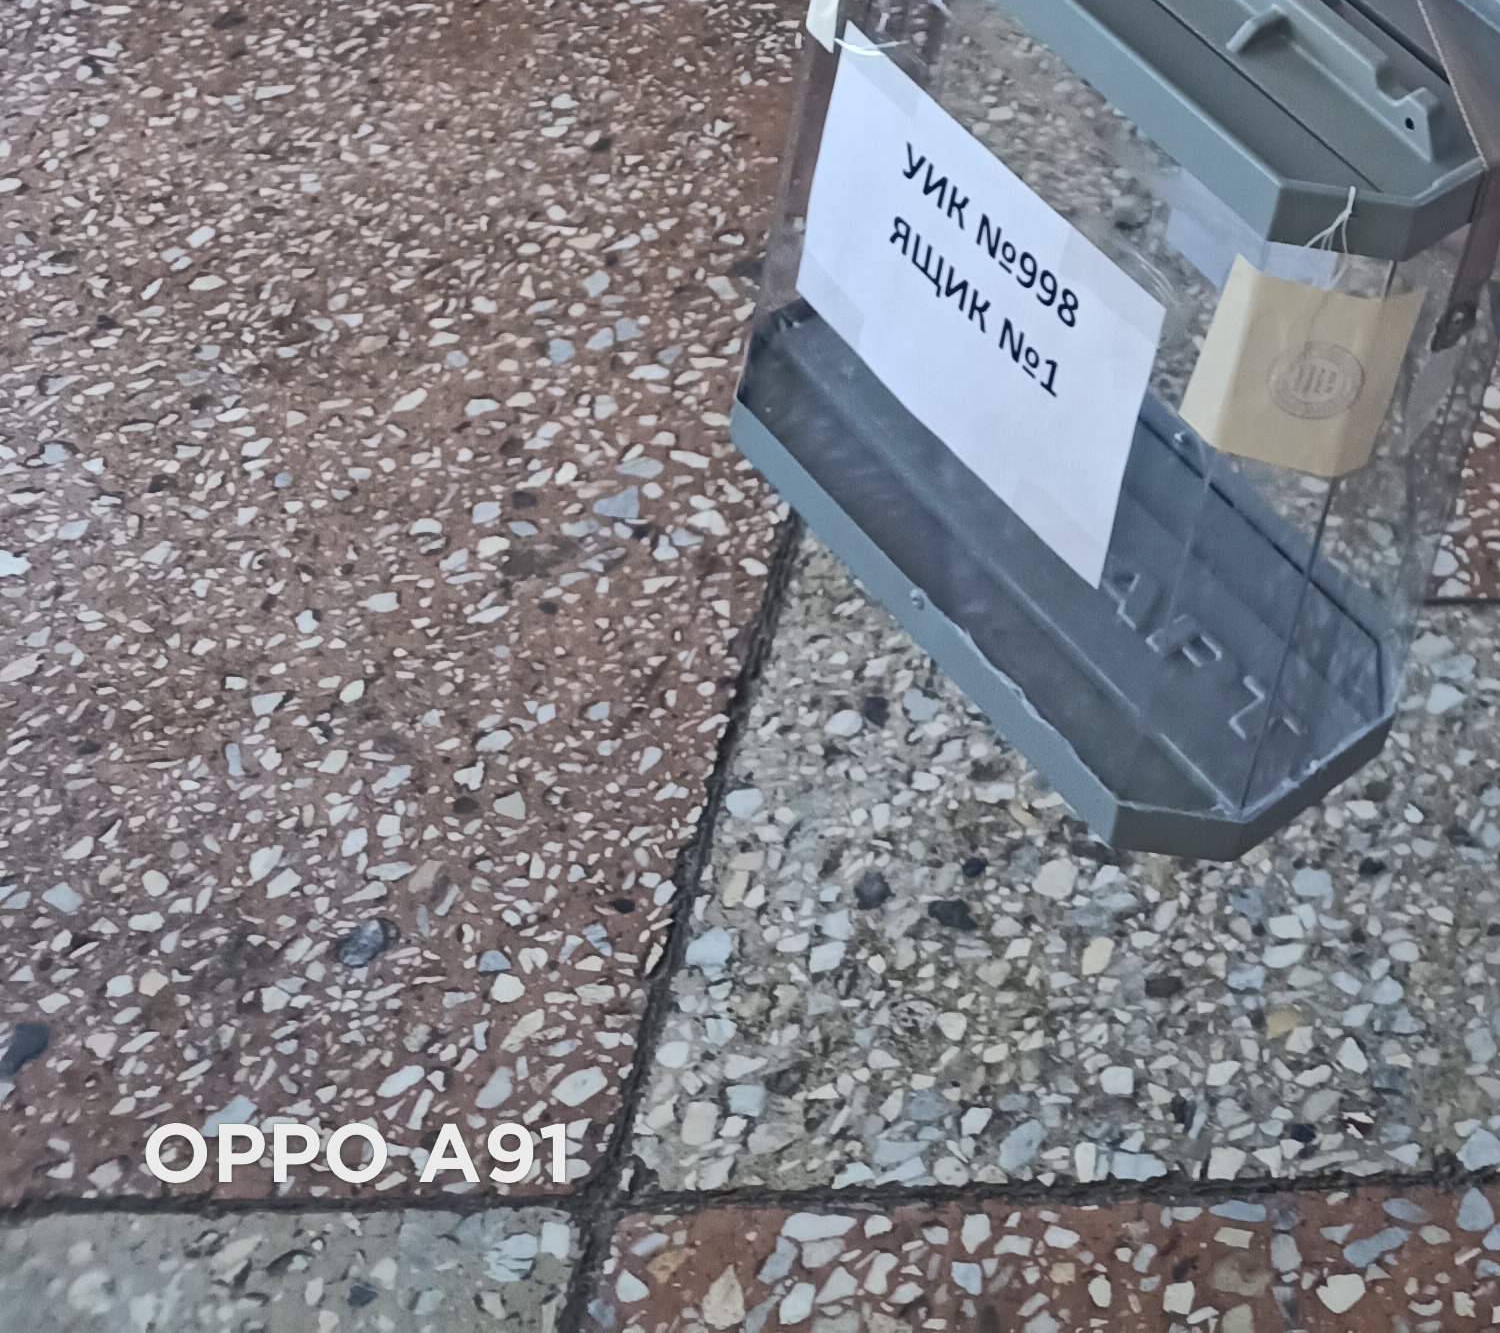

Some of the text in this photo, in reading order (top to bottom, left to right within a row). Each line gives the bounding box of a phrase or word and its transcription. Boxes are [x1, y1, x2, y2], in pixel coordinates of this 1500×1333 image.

[888, 215, 1058, 398] ЯЩИК №1
[902, 141, 1080, 328] УИК №998
